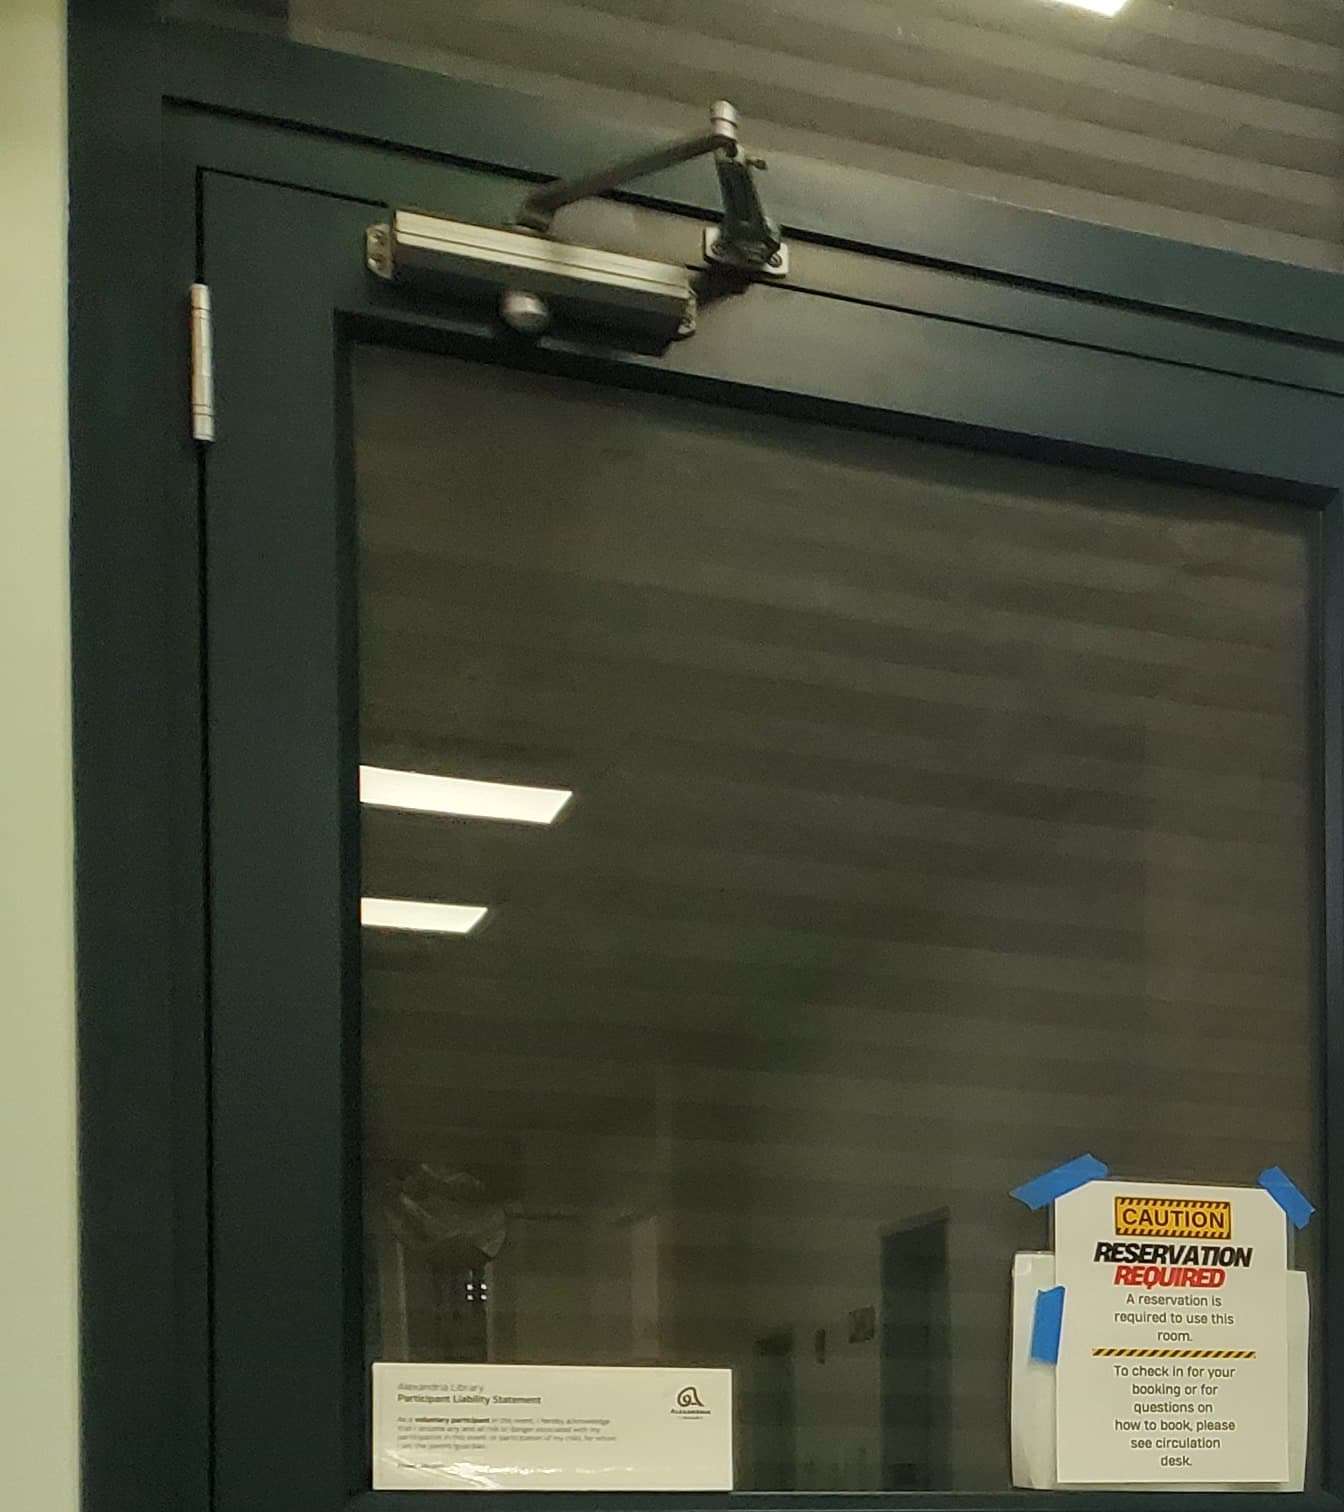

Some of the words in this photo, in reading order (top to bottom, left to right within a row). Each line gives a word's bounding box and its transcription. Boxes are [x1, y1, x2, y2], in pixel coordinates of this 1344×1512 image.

[1122, 1208, 1225, 1229] CAUTION
[1093, 1241, 1253, 1268] RESERVATION
[1113, 1264, 1226, 1290] REQUIRED
[1126, 1293, 1135, 1305] A
[1138, 1294, 1208, 1307] reservation
[1211, 1295, 1222, 1307] is
[1114, 1310, 1167, 1325] required
[1170, 1312, 1183, 1324] to
[1186, 1314, 1208, 1325] use
[1211, 1313, 1234, 1325] this
[1157, 1331, 1193, 1342] room.
[1113, 1365, 1129, 1377] To
[1131, 1365, 1169, 1377] check
[1172, 1365, 1184, 1377] in
[1187, 1365, 1205, 1378] for
[1207, 1368, 1236, 1380] your
[1132, 1383, 1181, 1398] booking
[1184, 1385, 1198, 1396] or
[1200, 1383, 1218, 1396] for
[1133, 1401, 1195, 1415] questions
[1197, 1403, 1213, 1413] on
[1114, 1419, 1141, 1431] how
[1143, 1420, 1157, 1431] to
[1160, 1419, 1193, 1432] book,
[1196, 1420, 1236, 1433] please
[1130, 1438, 1152, 1449] see
[1155, 1437, 1221, 1449] circulation
[1160, 1455, 1193, 1467] desk.
